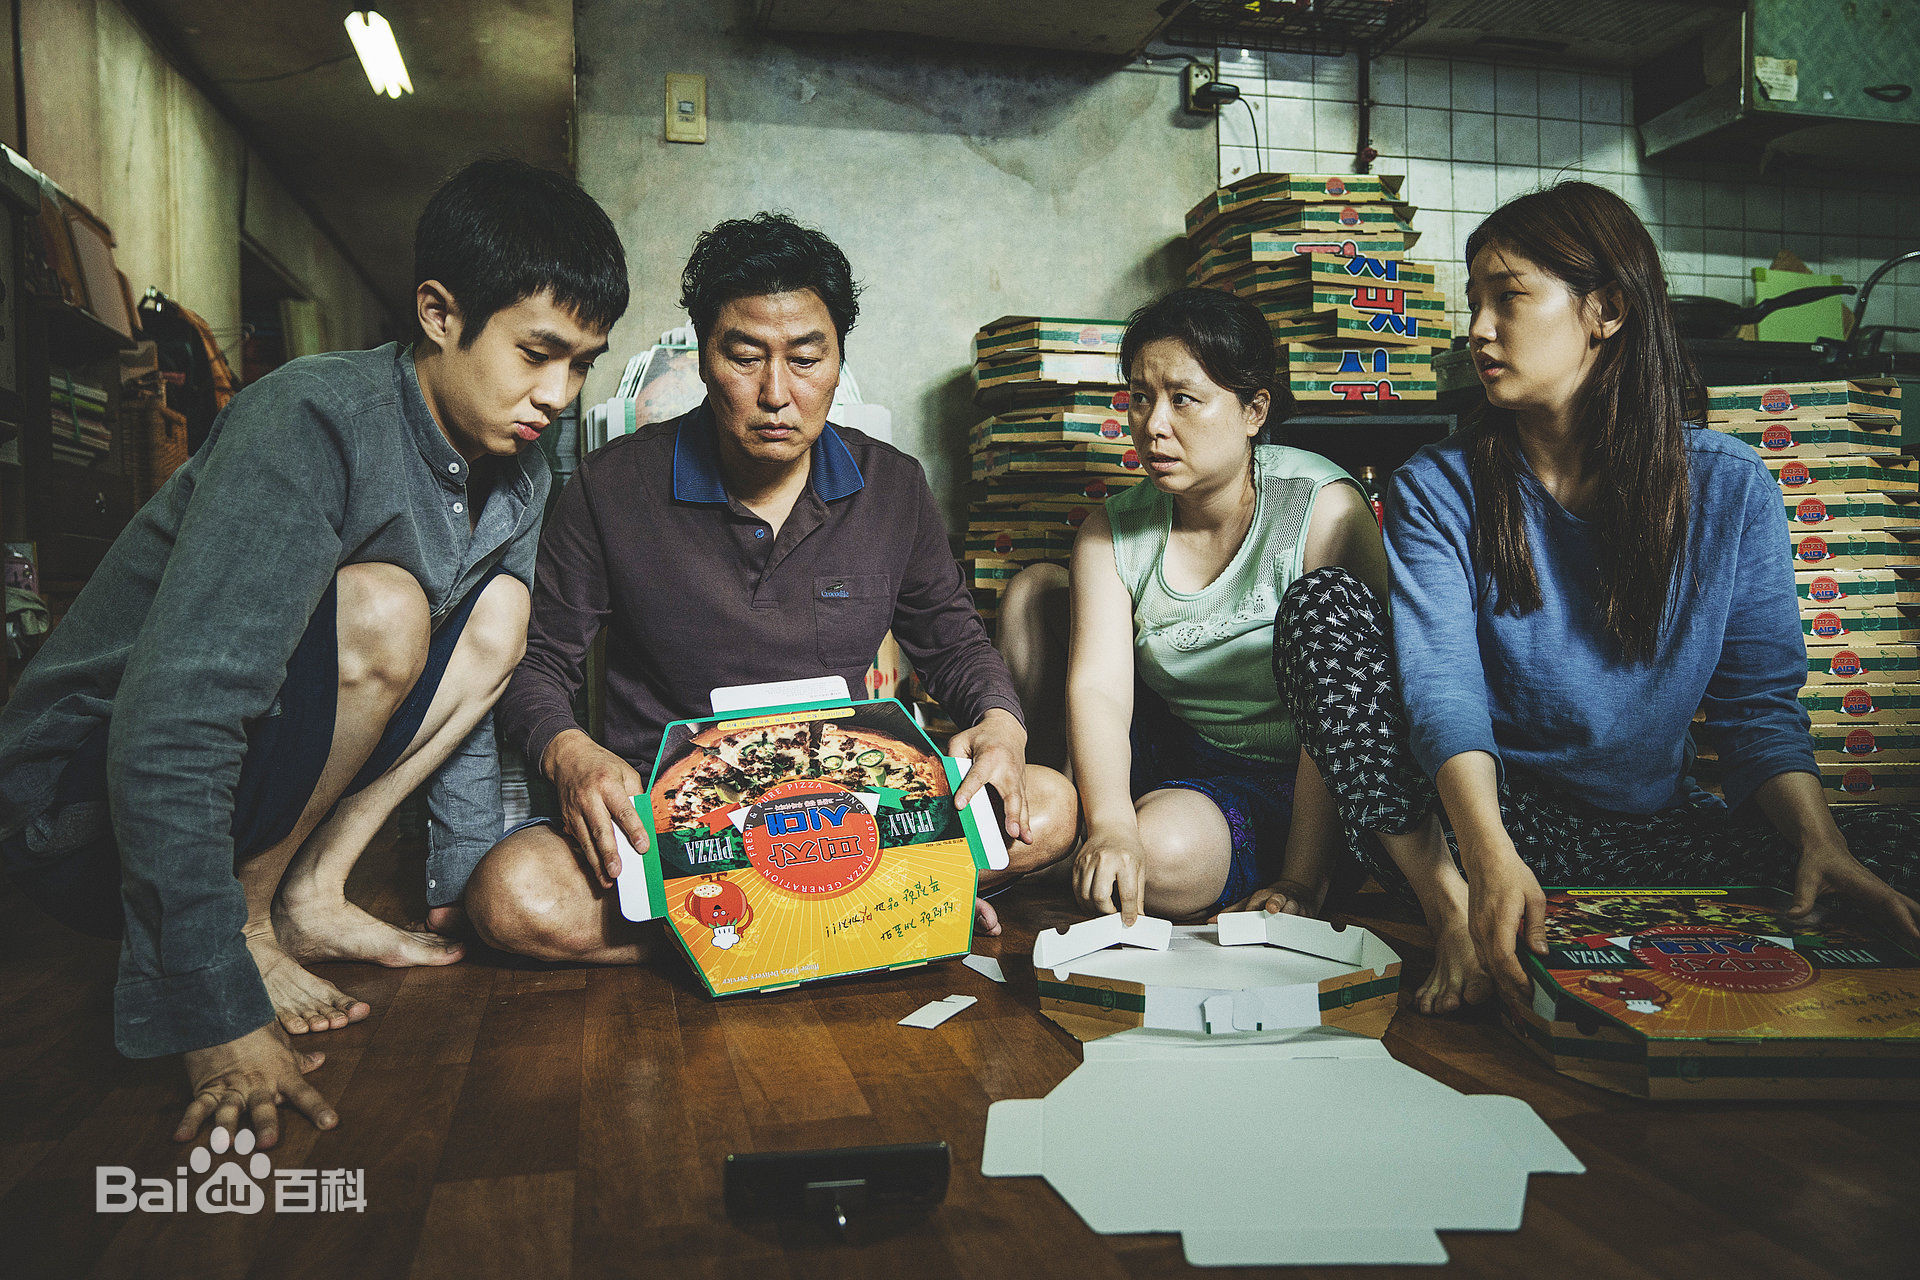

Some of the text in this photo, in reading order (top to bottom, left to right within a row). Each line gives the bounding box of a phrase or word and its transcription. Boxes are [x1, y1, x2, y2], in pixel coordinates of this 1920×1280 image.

[745, 823, 757, 857] FRESH
[757, 787, 782, 808] PURE
[787, 781, 823, 790] PIZZA
[764, 804, 851, 837] 시대
[838, 789, 876, 842] SINCE 2010
[888, 810, 935, 836] ITALY
[684, 836, 734, 865] PIZZA
[768, 835, 864, 869] 피자
[762, 855, 873, 893] PIZZA GENERATION
[825, 875, 940, 937] 푸짐한 양과 맛까지!!
[880, 901, 954, 941] 신선한 재료와
[1562, 950, 1627, 964] PIZZA
[1650, 940, 1760, 955] 시대
[1812, 949, 1881, 963] ITALY
[750, 970, 779, 980] Delivery
[781, 967, 799, 975] Pizza
[1669, 957, 1795, 972] 피자
[722, 975, 748, 984] Service
